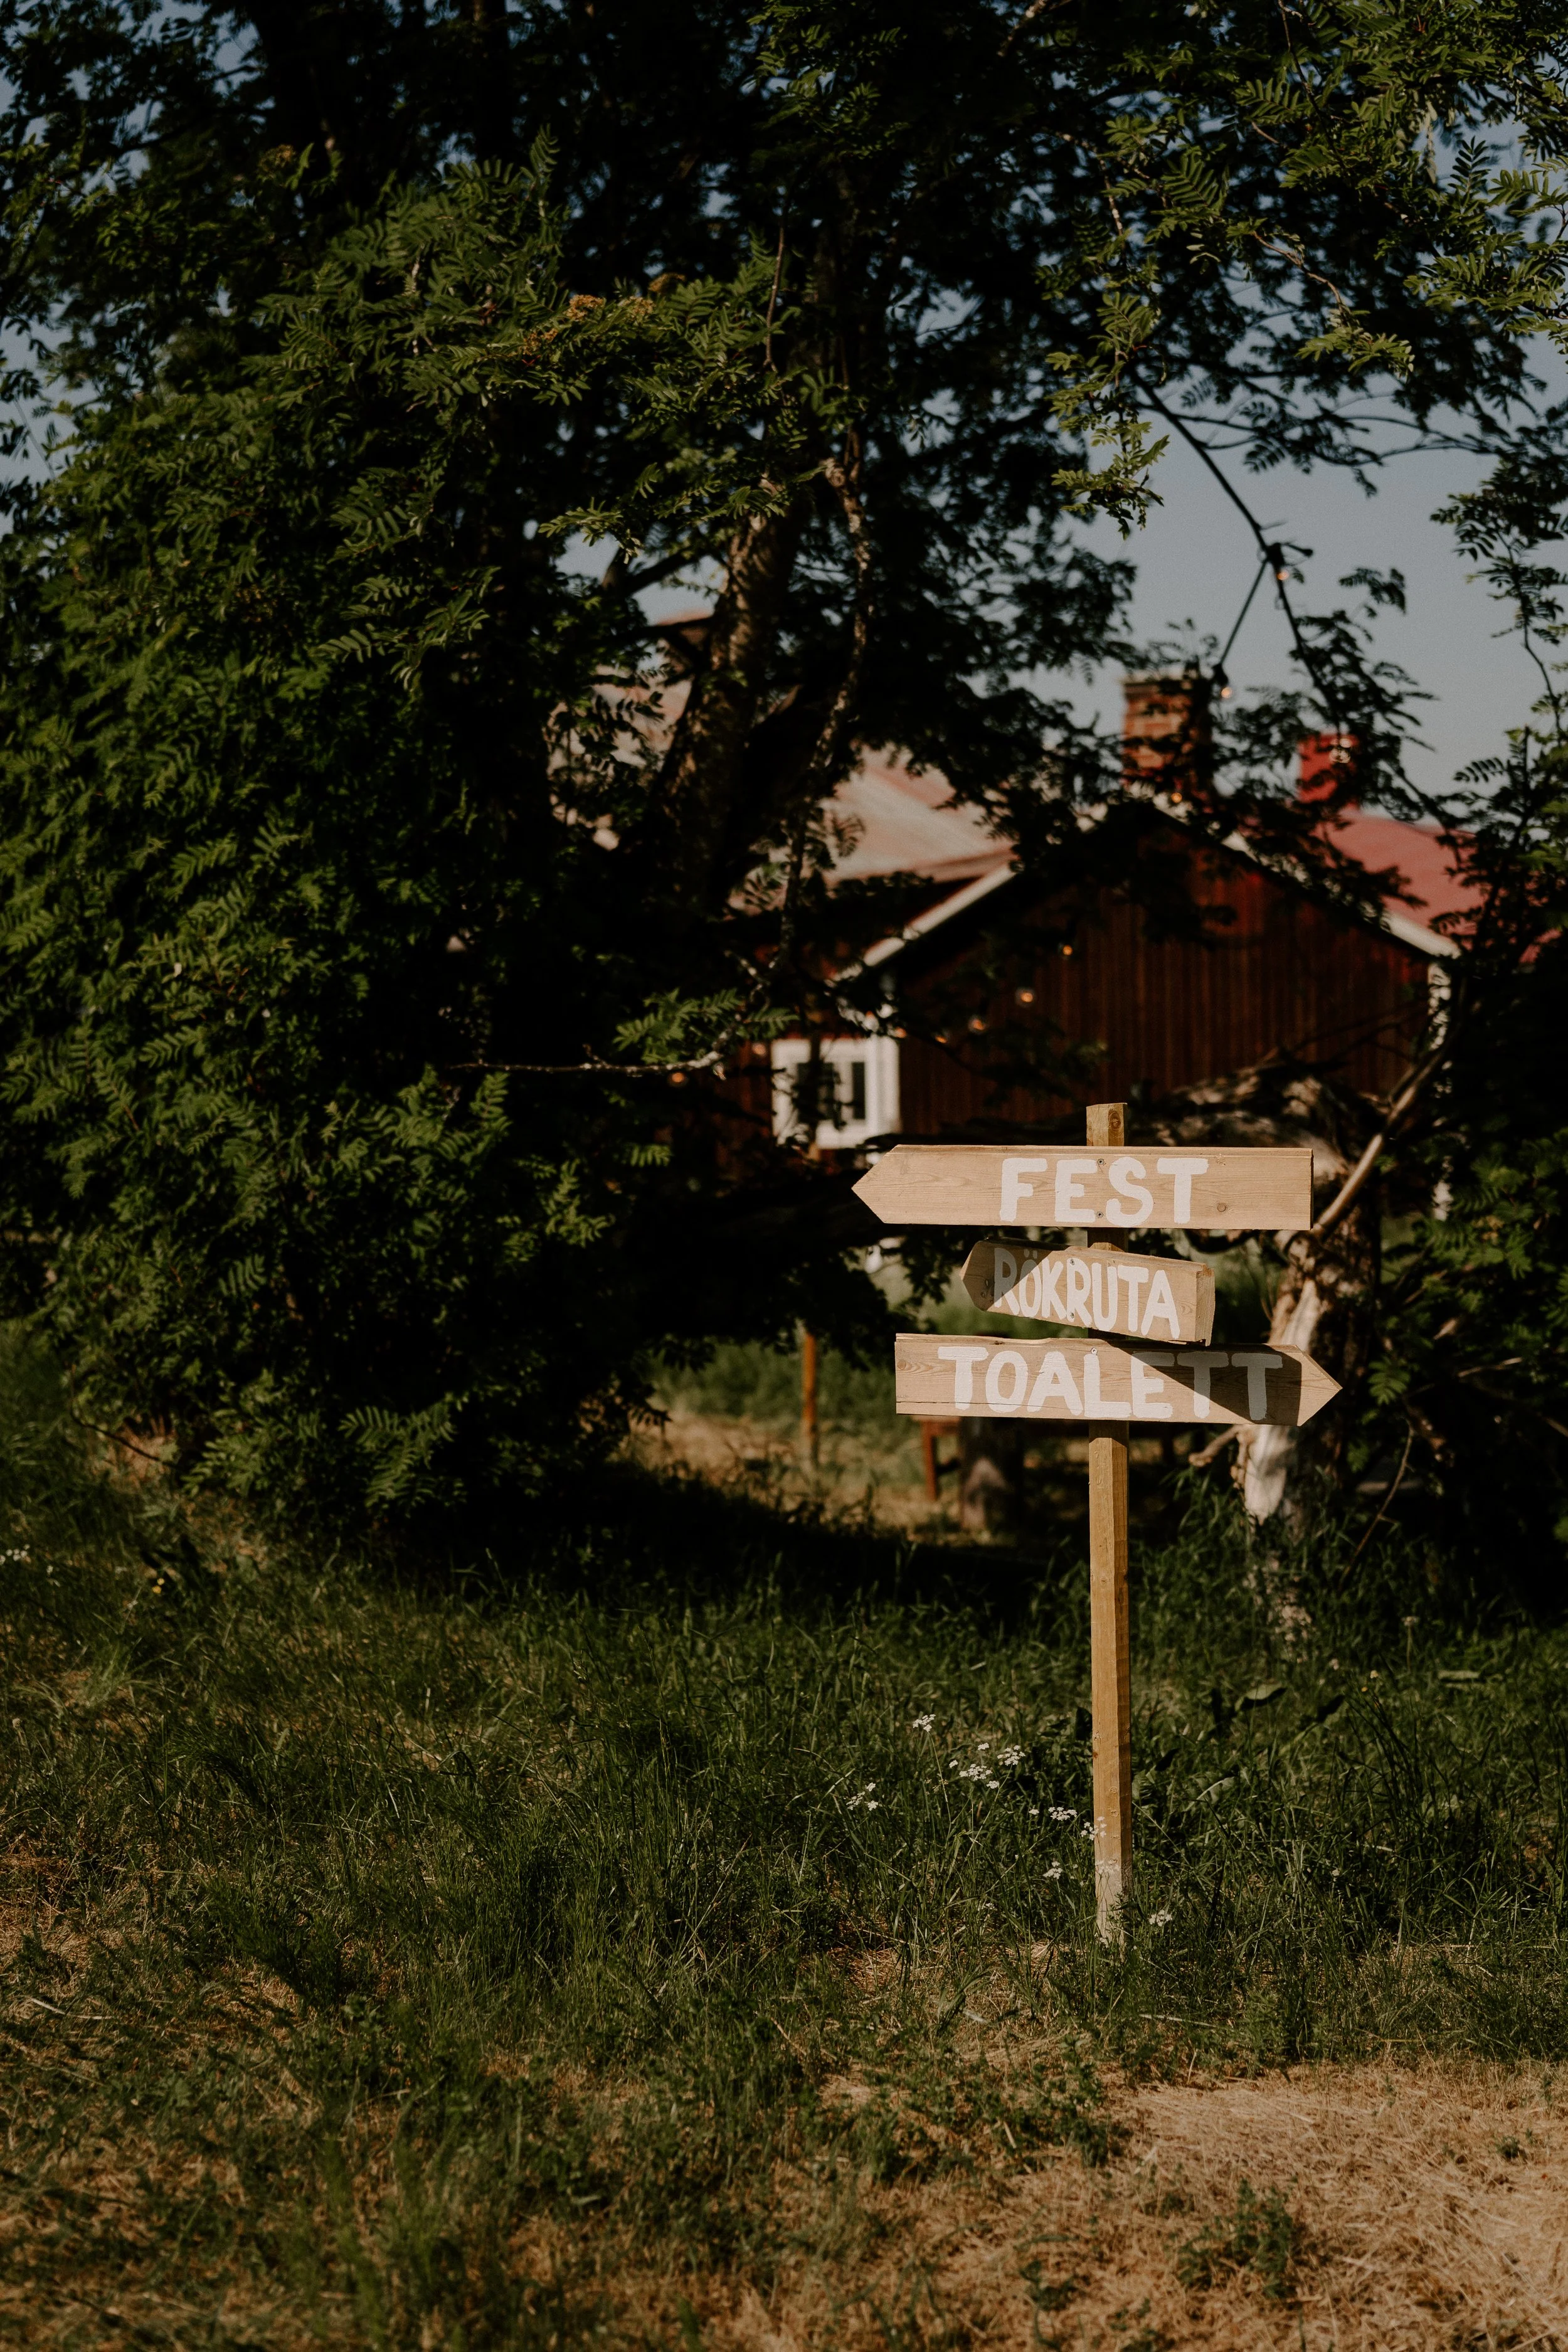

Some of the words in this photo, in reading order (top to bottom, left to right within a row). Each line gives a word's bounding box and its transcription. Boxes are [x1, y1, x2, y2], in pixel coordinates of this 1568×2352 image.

[1000, 1157, 1209, 1226] FEST
[994, 1248, 1180, 1338] RÖKRUTA
[938, 1346, 1283, 1421] TOALETT
